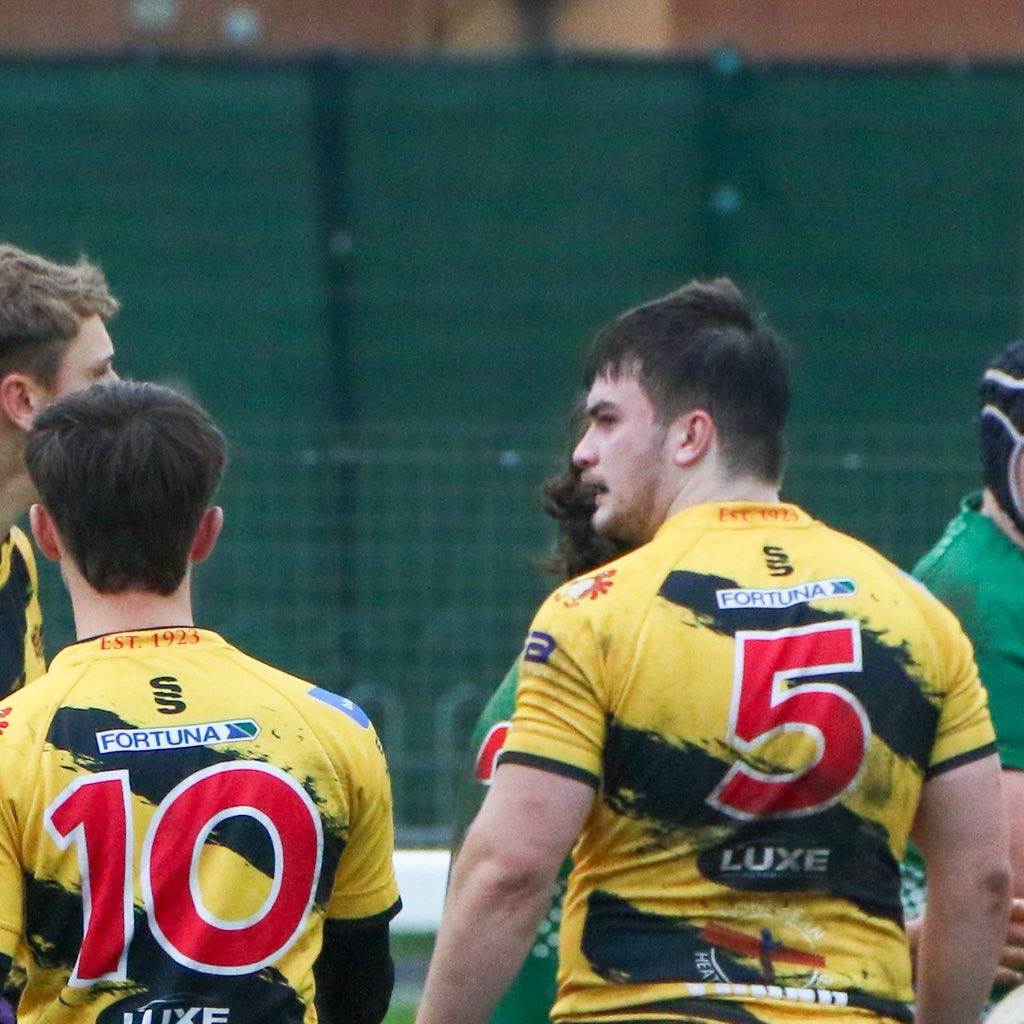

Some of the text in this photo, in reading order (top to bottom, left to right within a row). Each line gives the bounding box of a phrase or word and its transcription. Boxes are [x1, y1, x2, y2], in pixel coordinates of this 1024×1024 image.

[720, 583, 827, 607] FORTUNA
[101, 629, 200, 650] EST. 1923
[707, 620, 872, 822] 5
[102, 726, 220, 750] FORTUNA
[721, 848, 831, 872] LUXE
[44, 761, 324, 987] 10
